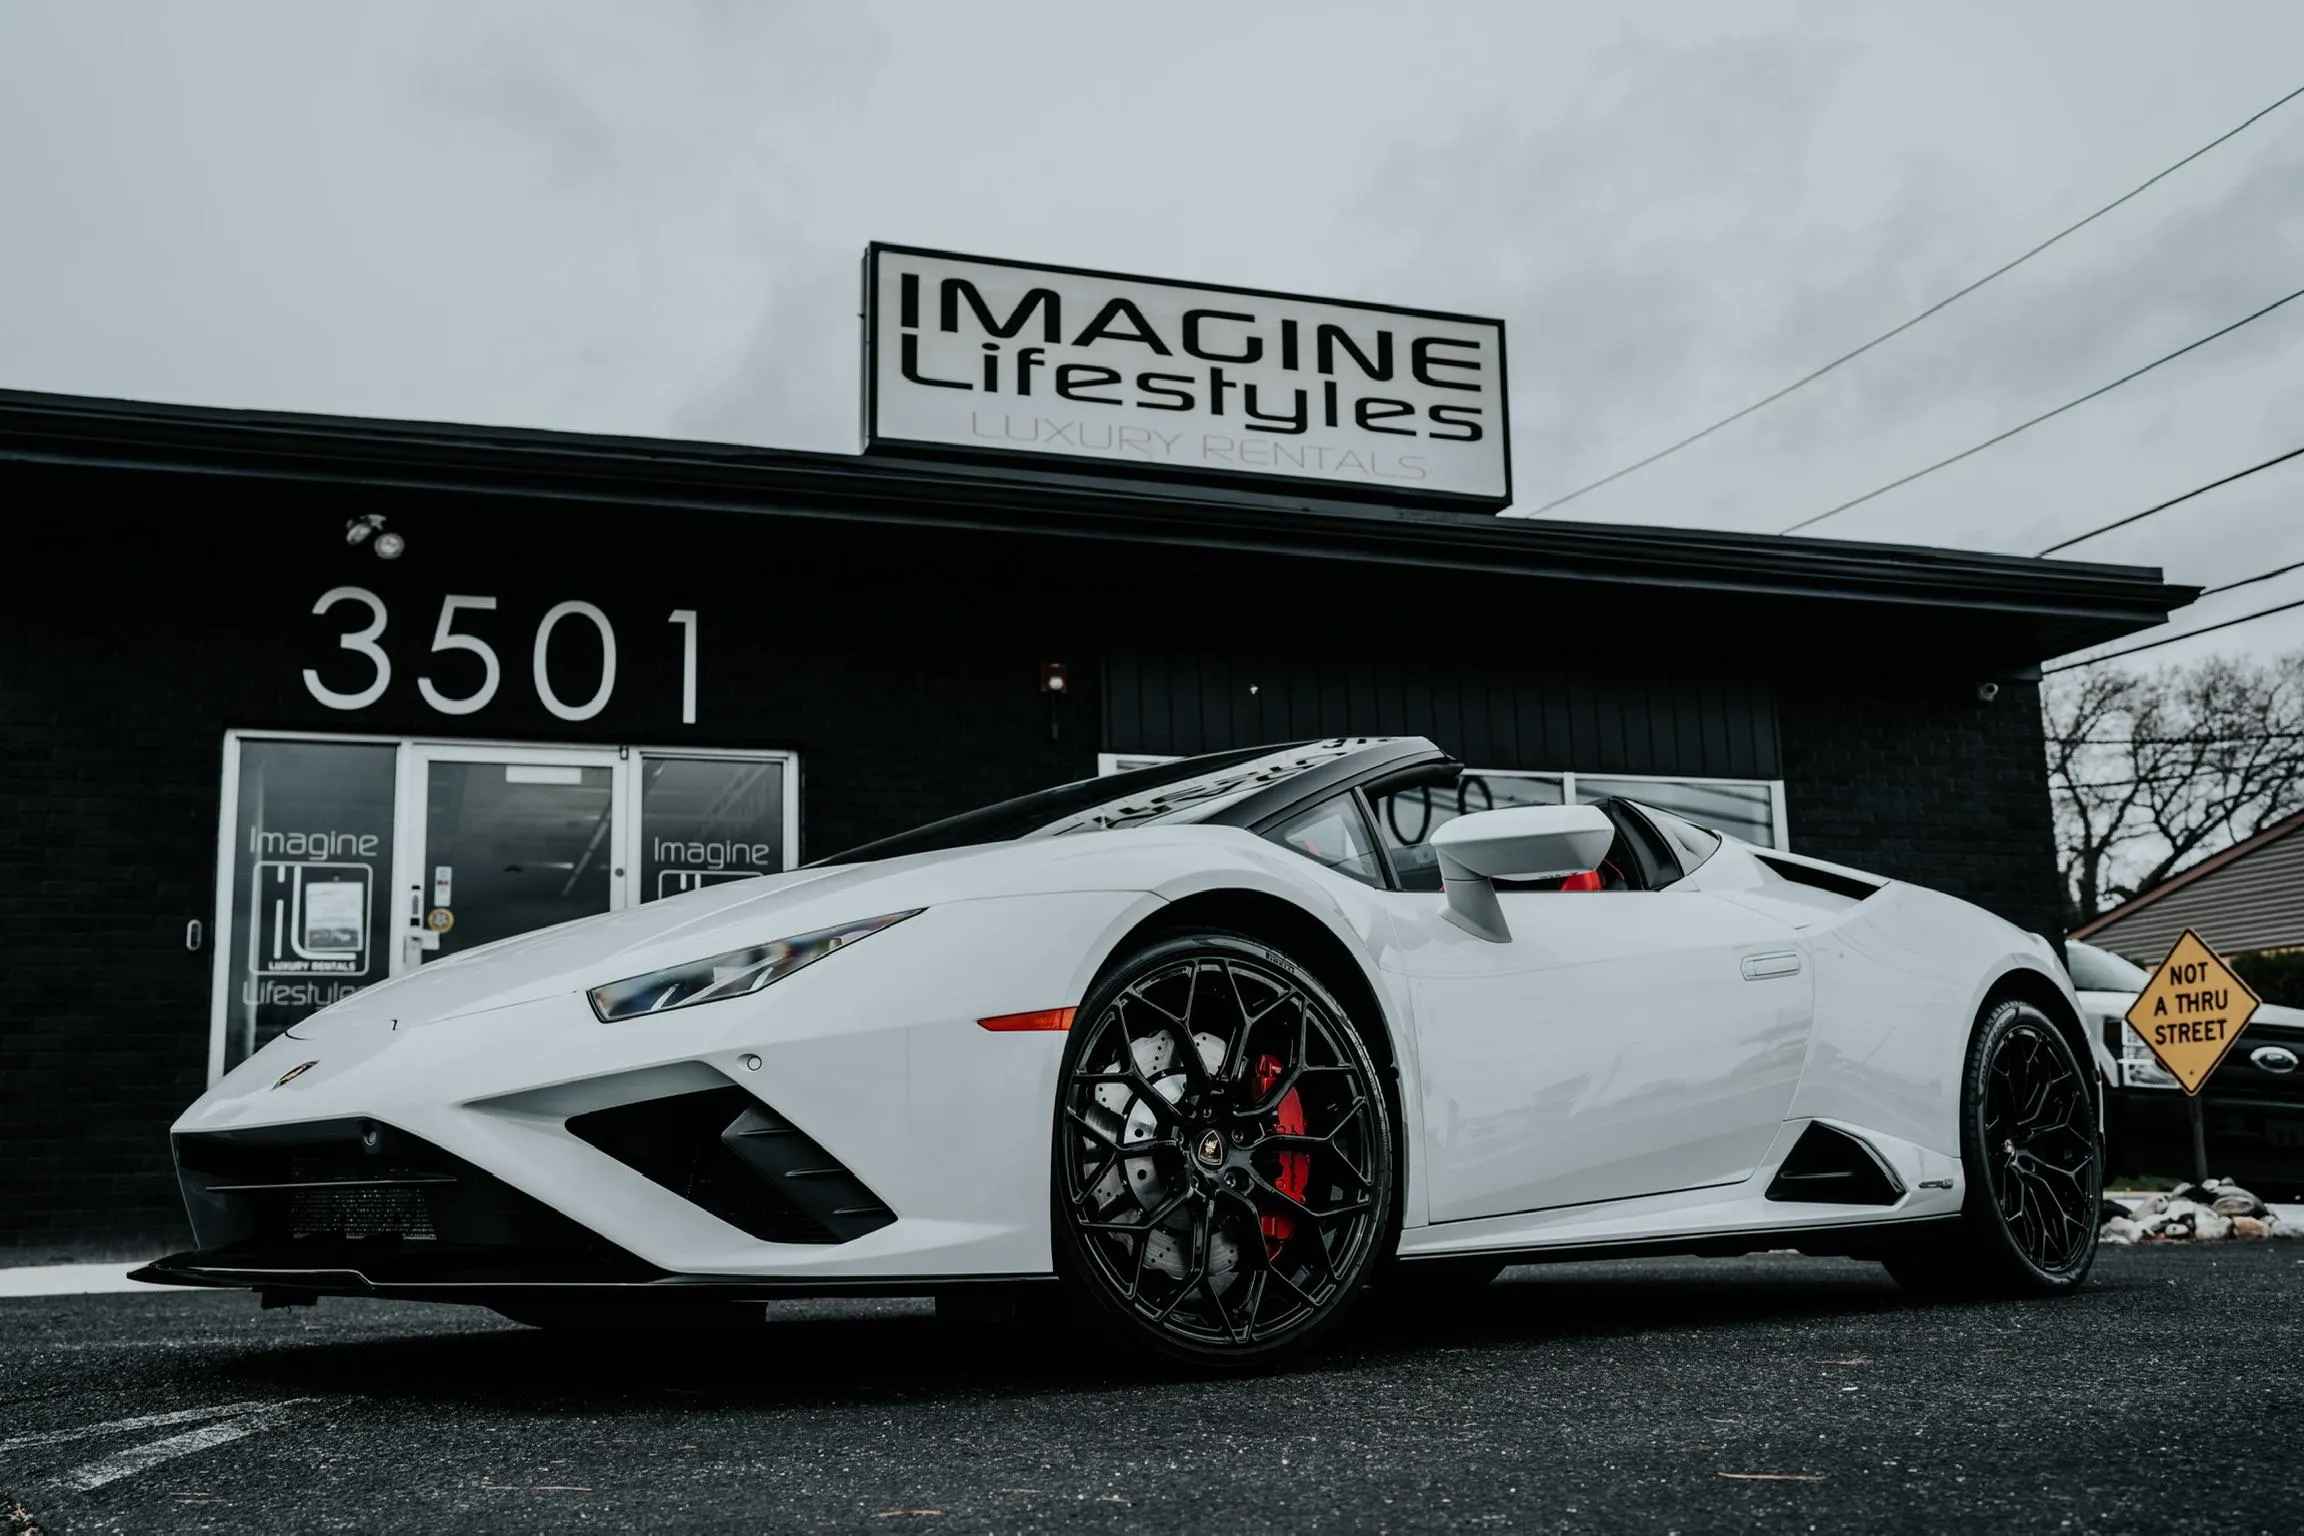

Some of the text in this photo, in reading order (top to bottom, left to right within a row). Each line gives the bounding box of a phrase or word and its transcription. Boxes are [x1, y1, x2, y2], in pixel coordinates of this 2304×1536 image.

[900, 272, 1482, 392] IMAGINE
[900, 333, 1484, 442] Lifestyles
[971, 411, 1427, 481] LUXURY RENTALS
[303, 586, 697, 724] 3501
[250, 825, 379, 861] Imagine
[654, 837, 770, 870] Imagine
[2170, 962, 2208, 986] NOT
[2153, 989, 2229, 1017] A THRU
[2155, 1019, 2227, 1045] STREET
